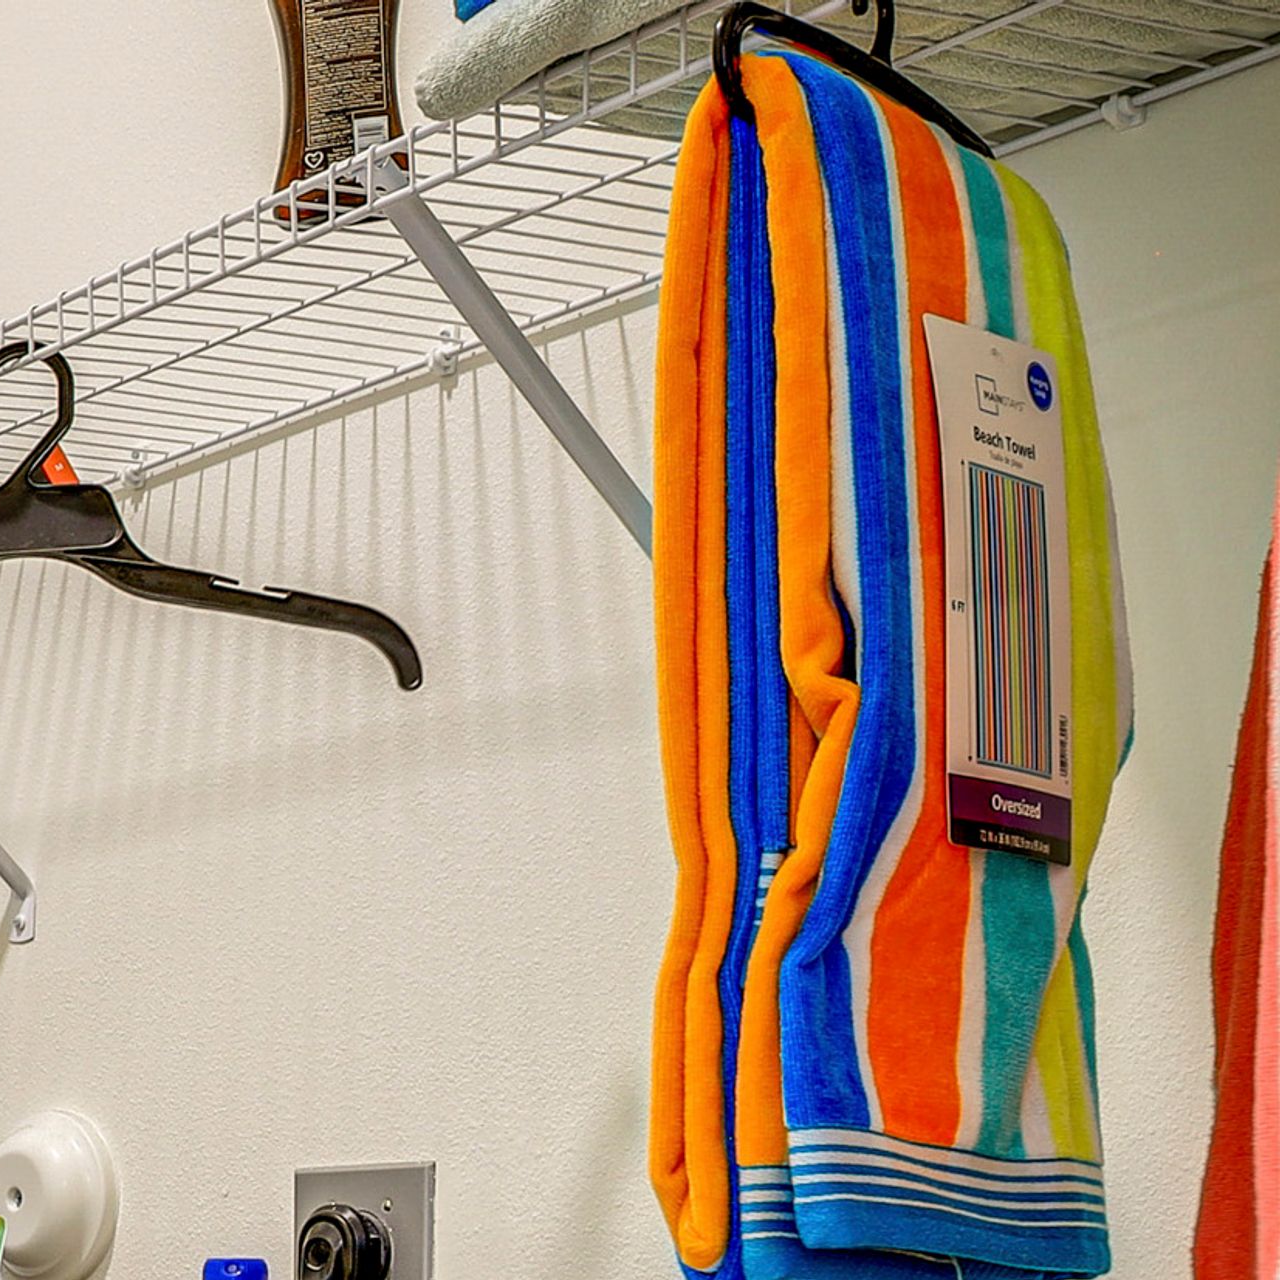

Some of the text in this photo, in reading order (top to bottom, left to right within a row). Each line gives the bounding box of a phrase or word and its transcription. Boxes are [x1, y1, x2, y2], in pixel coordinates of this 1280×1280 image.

[973, 426, 1036, 460] Beach Towel
[991, 794, 1042, 820] Oversized
